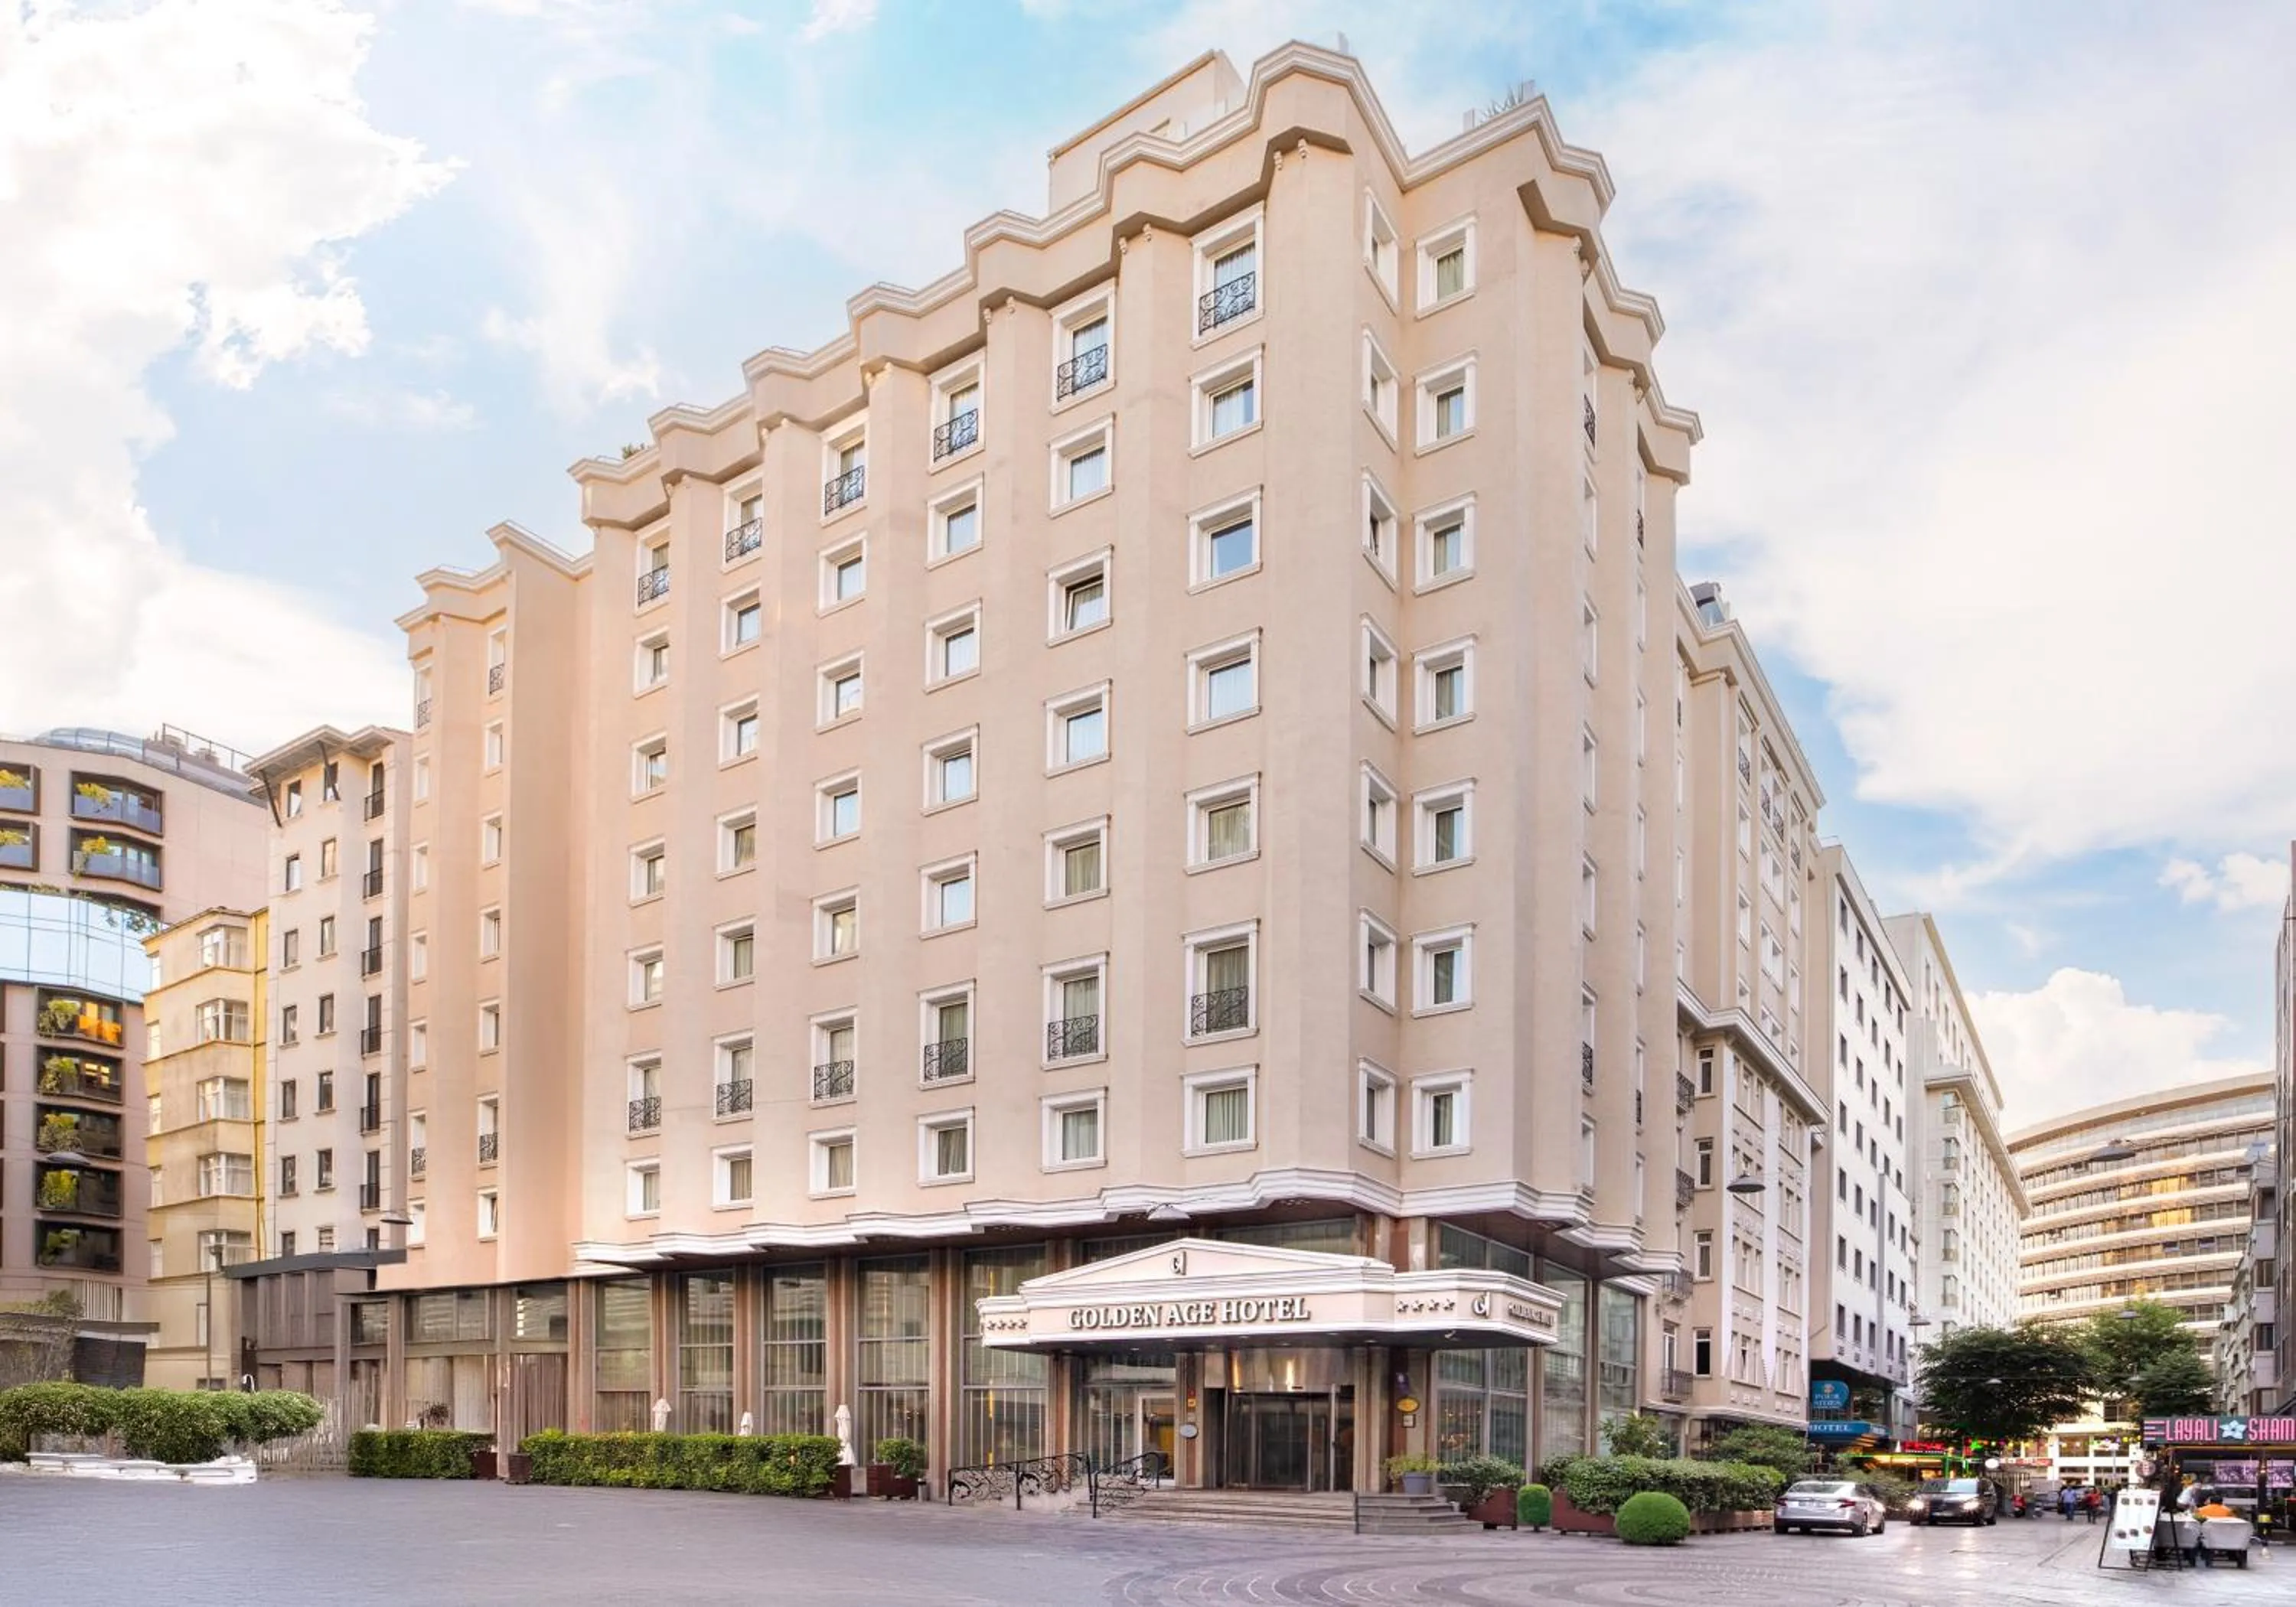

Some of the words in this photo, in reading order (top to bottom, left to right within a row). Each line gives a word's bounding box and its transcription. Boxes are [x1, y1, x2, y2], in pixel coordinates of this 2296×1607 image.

[1068, 1305, 1162, 1331] GOLDEN
[1166, 1302, 1215, 1327] AGE
[1221, 1298, 1310, 1325] HOTEL
[2165, 1419, 2219, 1442] LAYALI
[2248, 1417, 2296, 1442] SHAM
